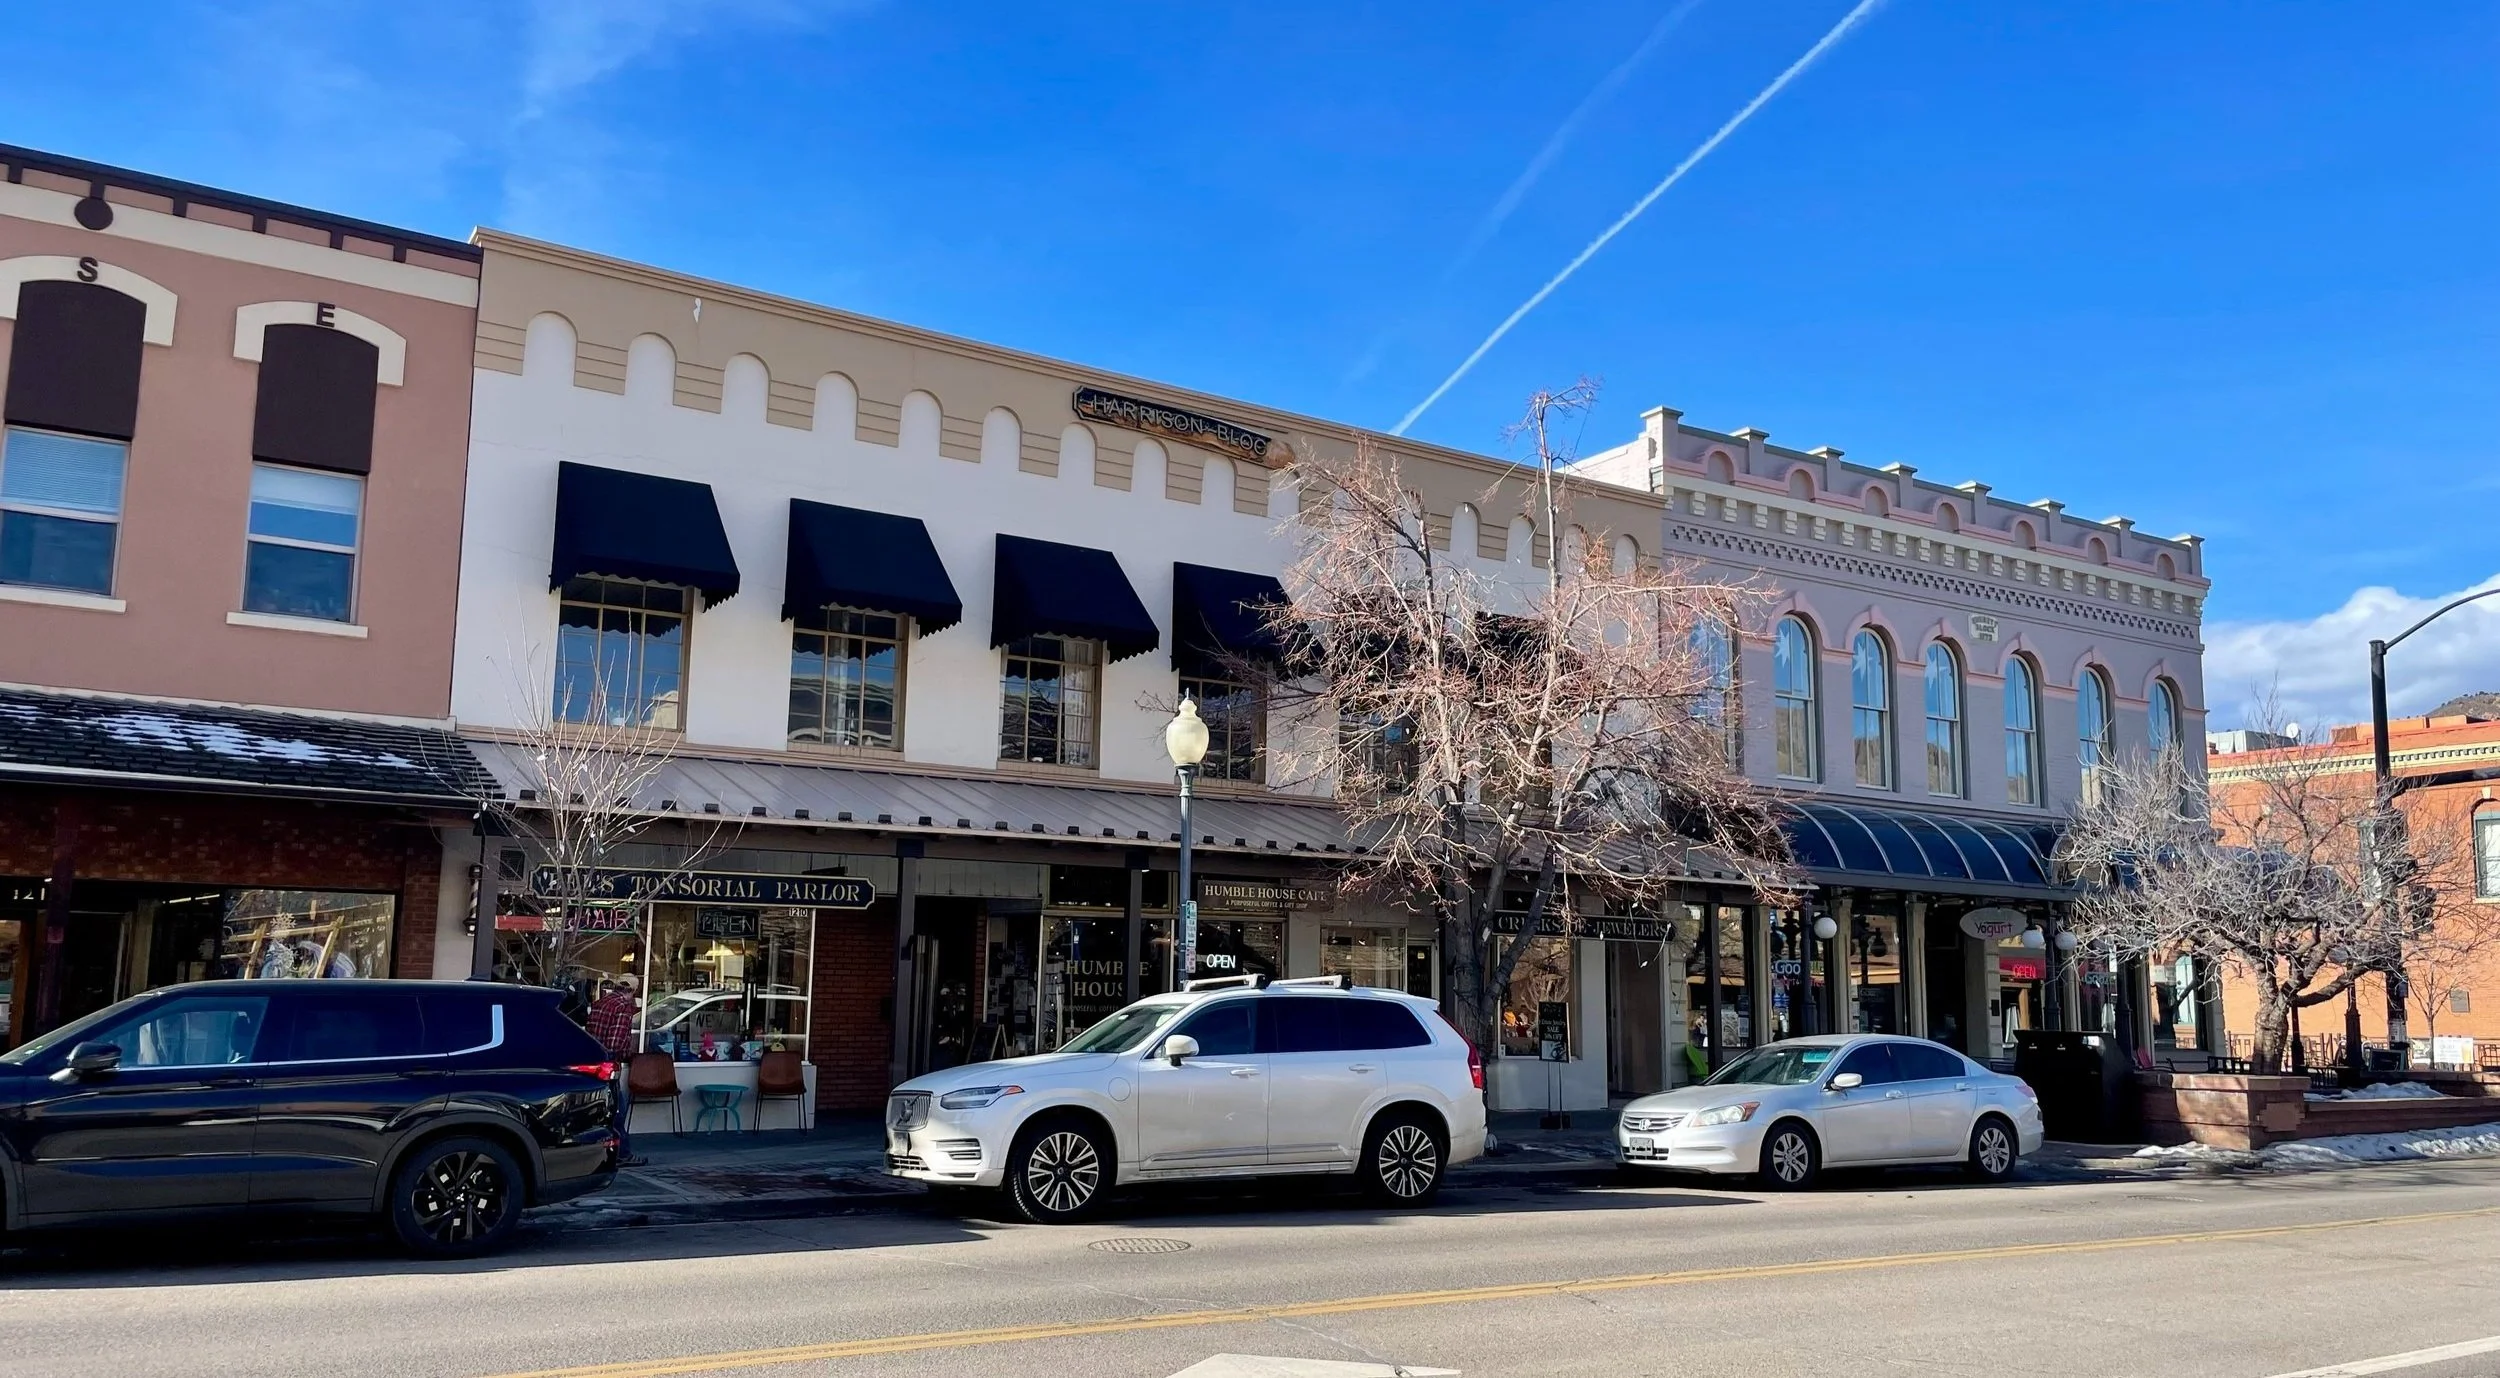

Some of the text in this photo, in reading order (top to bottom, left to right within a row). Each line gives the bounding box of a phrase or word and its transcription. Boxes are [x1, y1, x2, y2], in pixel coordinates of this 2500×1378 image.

[77, 256, 336, 328] S E
[1094, 393, 1203, 434] HARRISON
[631, 875, 761, 898] TONSORIAL
[775, 881, 860, 901] PARLOR
[1205, 885, 1255, 898] HUMBLE
[1258, 888, 1296, 900] HOUSE
[701, 911, 755, 935] OPEN
[1592, 920, 1669, 938] JEWELERS
[1974, 921, 2014, 938] Yogurt
[1065, 959, 1150, 977] HUMBE
[1206, 953, 1236, 969] OPEN
[2012, 965, 2037, 979] OPEN
[1073, 982, 1124, 997] HOUS
